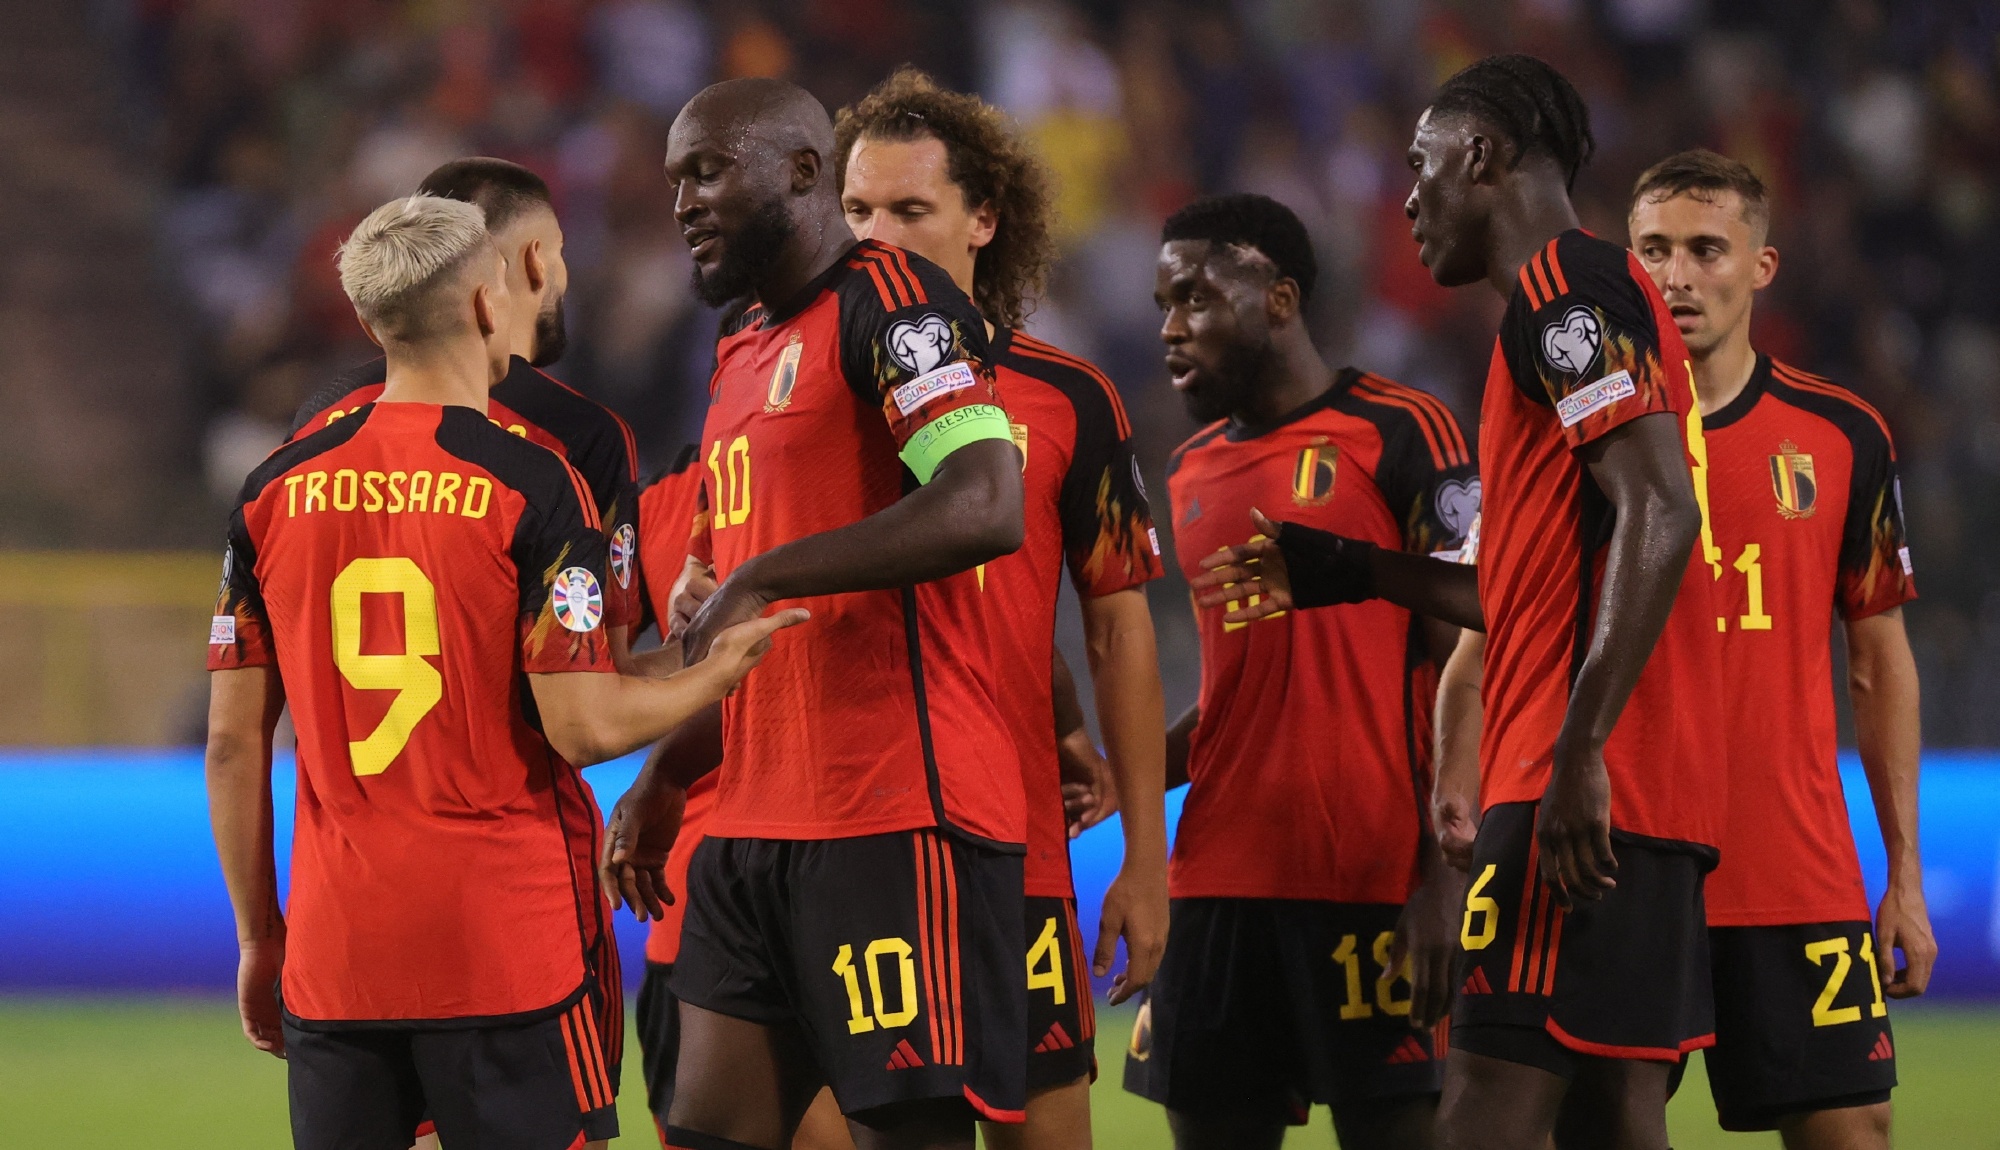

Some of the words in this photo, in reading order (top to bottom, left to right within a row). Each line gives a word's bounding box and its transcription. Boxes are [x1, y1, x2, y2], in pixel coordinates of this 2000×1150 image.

[895, 385, 910, 398] UEFA
[898, 370, 971, 407] FOUNDATION
[1560, 378, 1631, 418] FOUNDATION
[284, 468, 493, 519] TROSSARD
[707, 434, 751, 530] 10
[1713, 544, 1772, 632] 1
[331, 559, 442, 775] 9
[1460, 864, 1500, 951] 6
[831, 937, 919, 1035] 10
[1026, 917, 1066, 1005] 4
[1331, 931, 1413, 1020] 18
[1804, 932, 1888, 1027] 21
